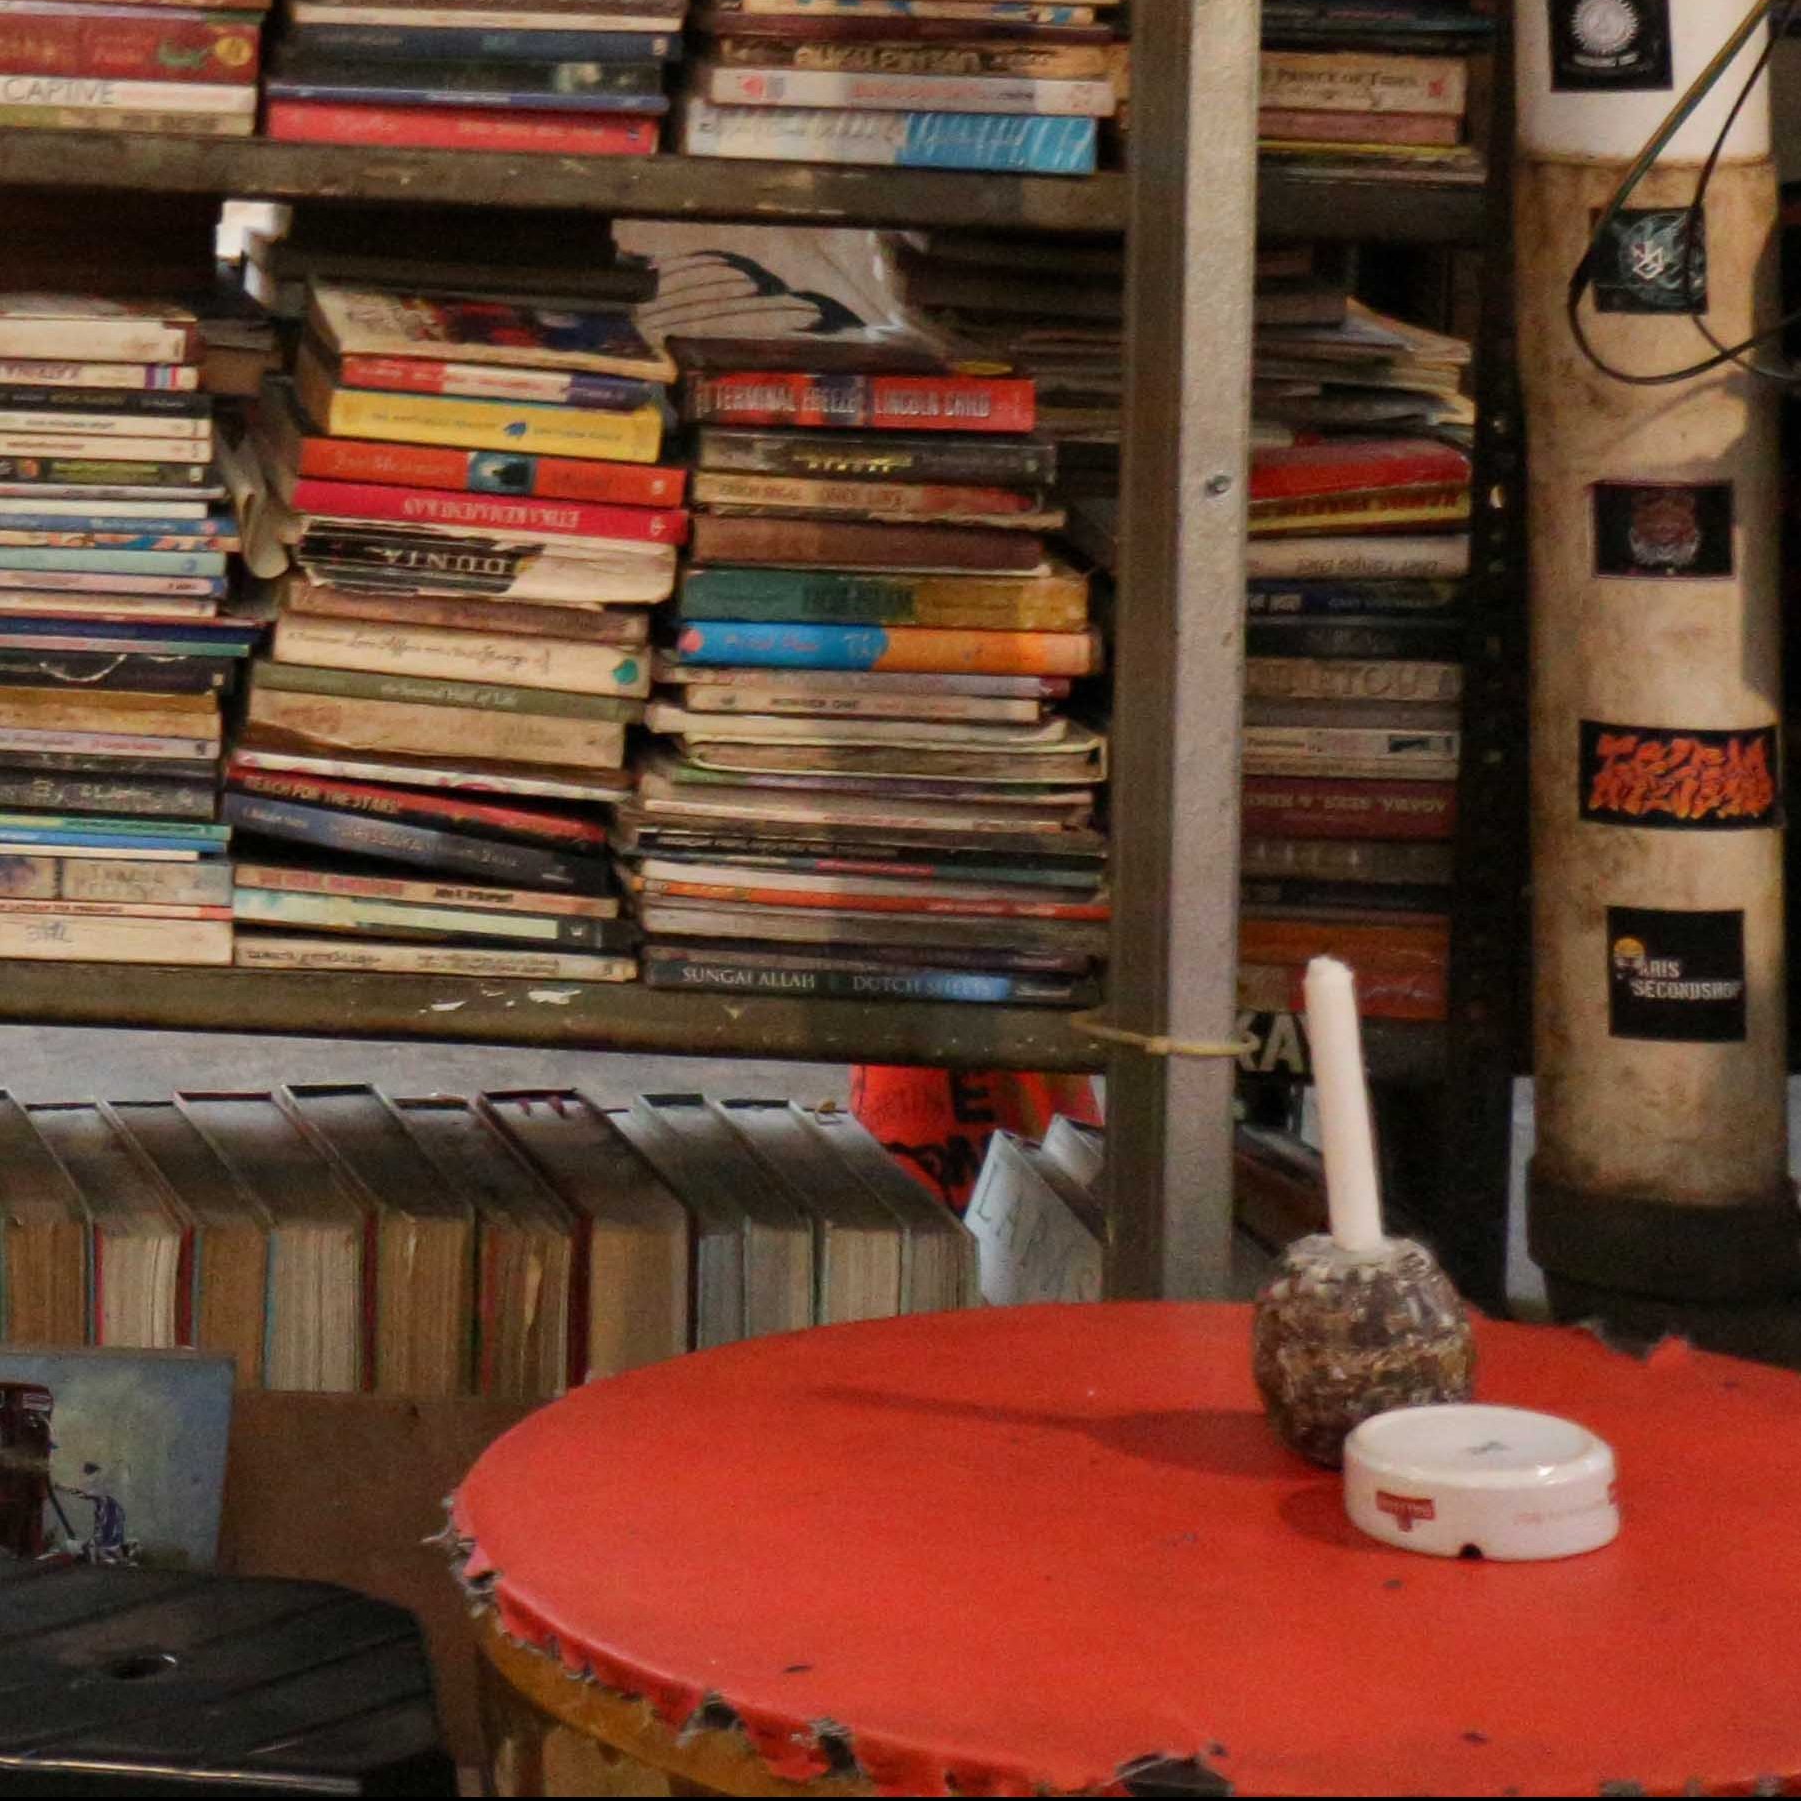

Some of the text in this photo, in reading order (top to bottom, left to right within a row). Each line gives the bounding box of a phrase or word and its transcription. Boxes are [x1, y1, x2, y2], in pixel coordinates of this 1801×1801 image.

[2, 75, 117, 105] CAPTIVE
[716, 386, 797, 412] TERMINAL
[682, 967, 753, 986] SUNGAI
[758, 970, 816, 989] ALLAH
